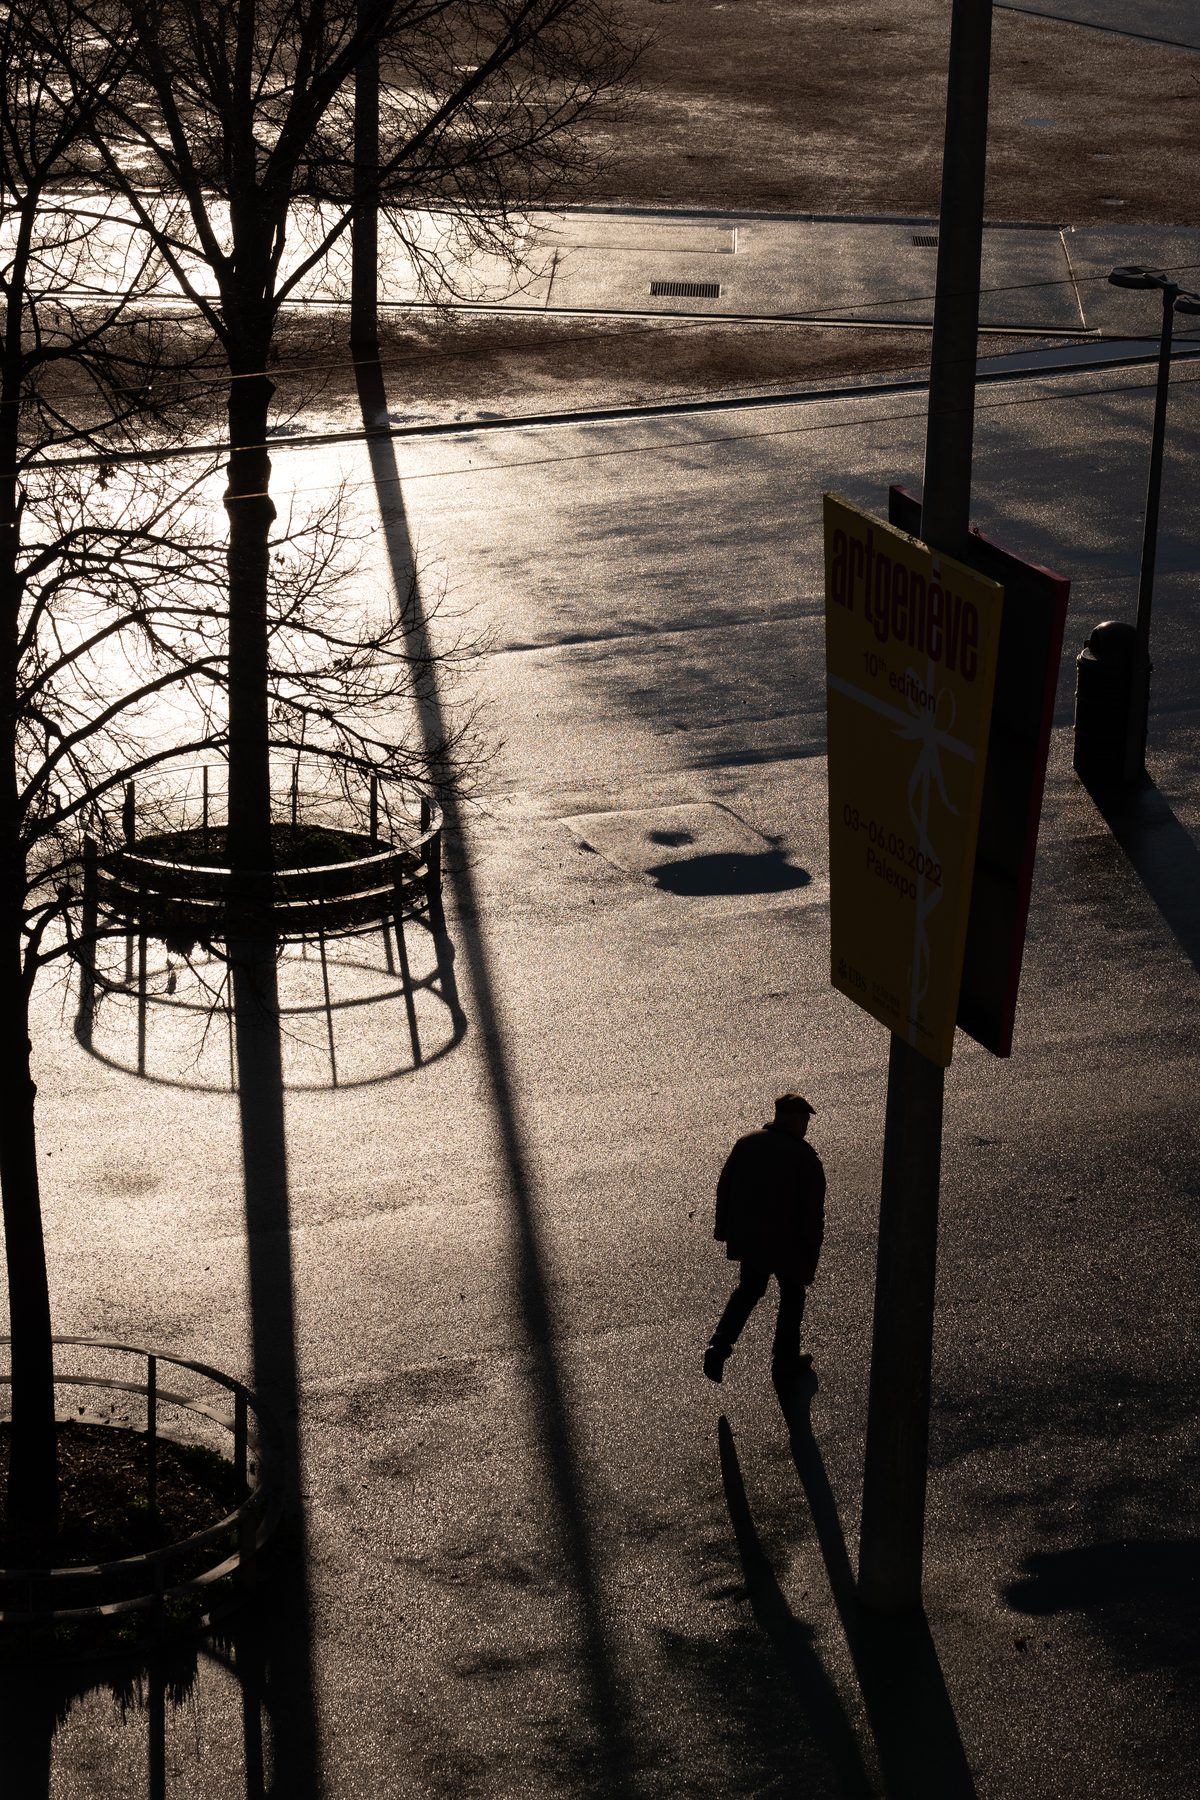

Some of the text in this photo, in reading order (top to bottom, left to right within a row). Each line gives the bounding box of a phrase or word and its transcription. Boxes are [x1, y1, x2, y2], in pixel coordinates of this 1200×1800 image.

[863, 650, 936, 713] 10th edition
[866, 847, 917, 900] Palexpo
[848, 965, 867, 992] UBS
